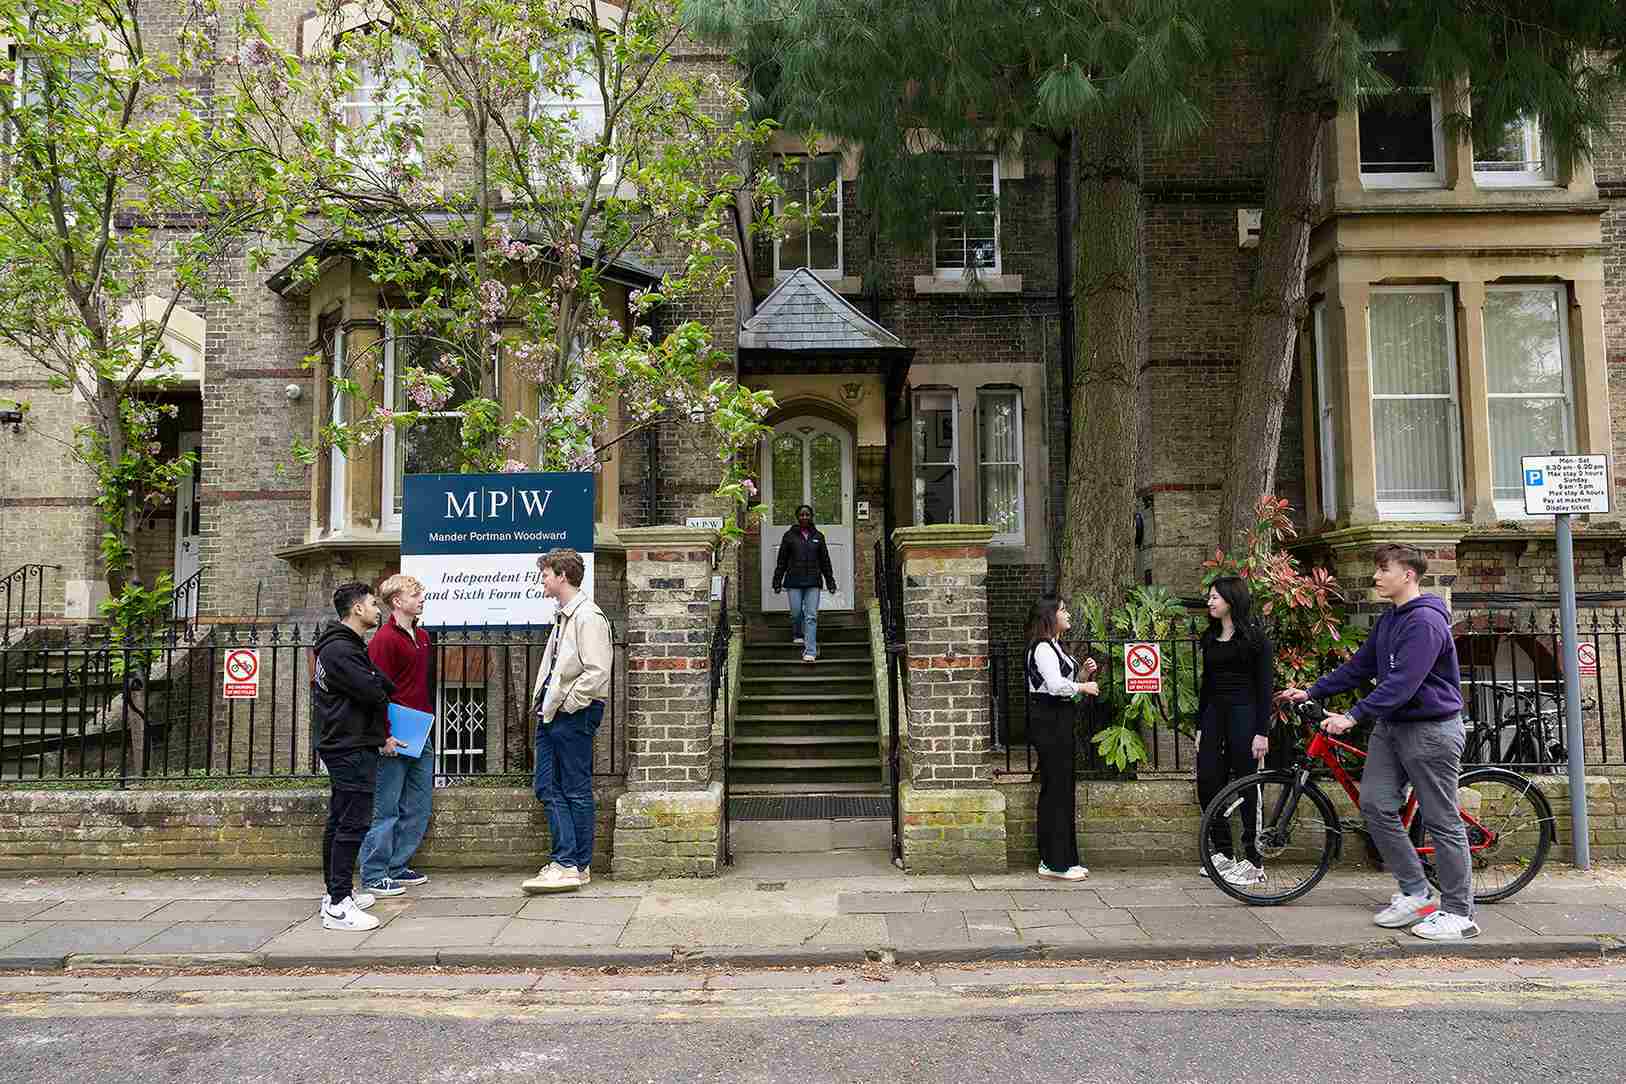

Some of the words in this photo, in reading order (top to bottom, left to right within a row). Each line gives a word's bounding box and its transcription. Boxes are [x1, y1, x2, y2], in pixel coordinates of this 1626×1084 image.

[429, 532, 467, 542] Mander
[470, 531, 512, 541] Portman
[513, 530, 567, 541] Woodward
[441, 571, 521, 586] Independent
[424, 589, 450, 601] and
[452, 588, 485, 600] Sixth
[489, 589, 521, 600] Form
